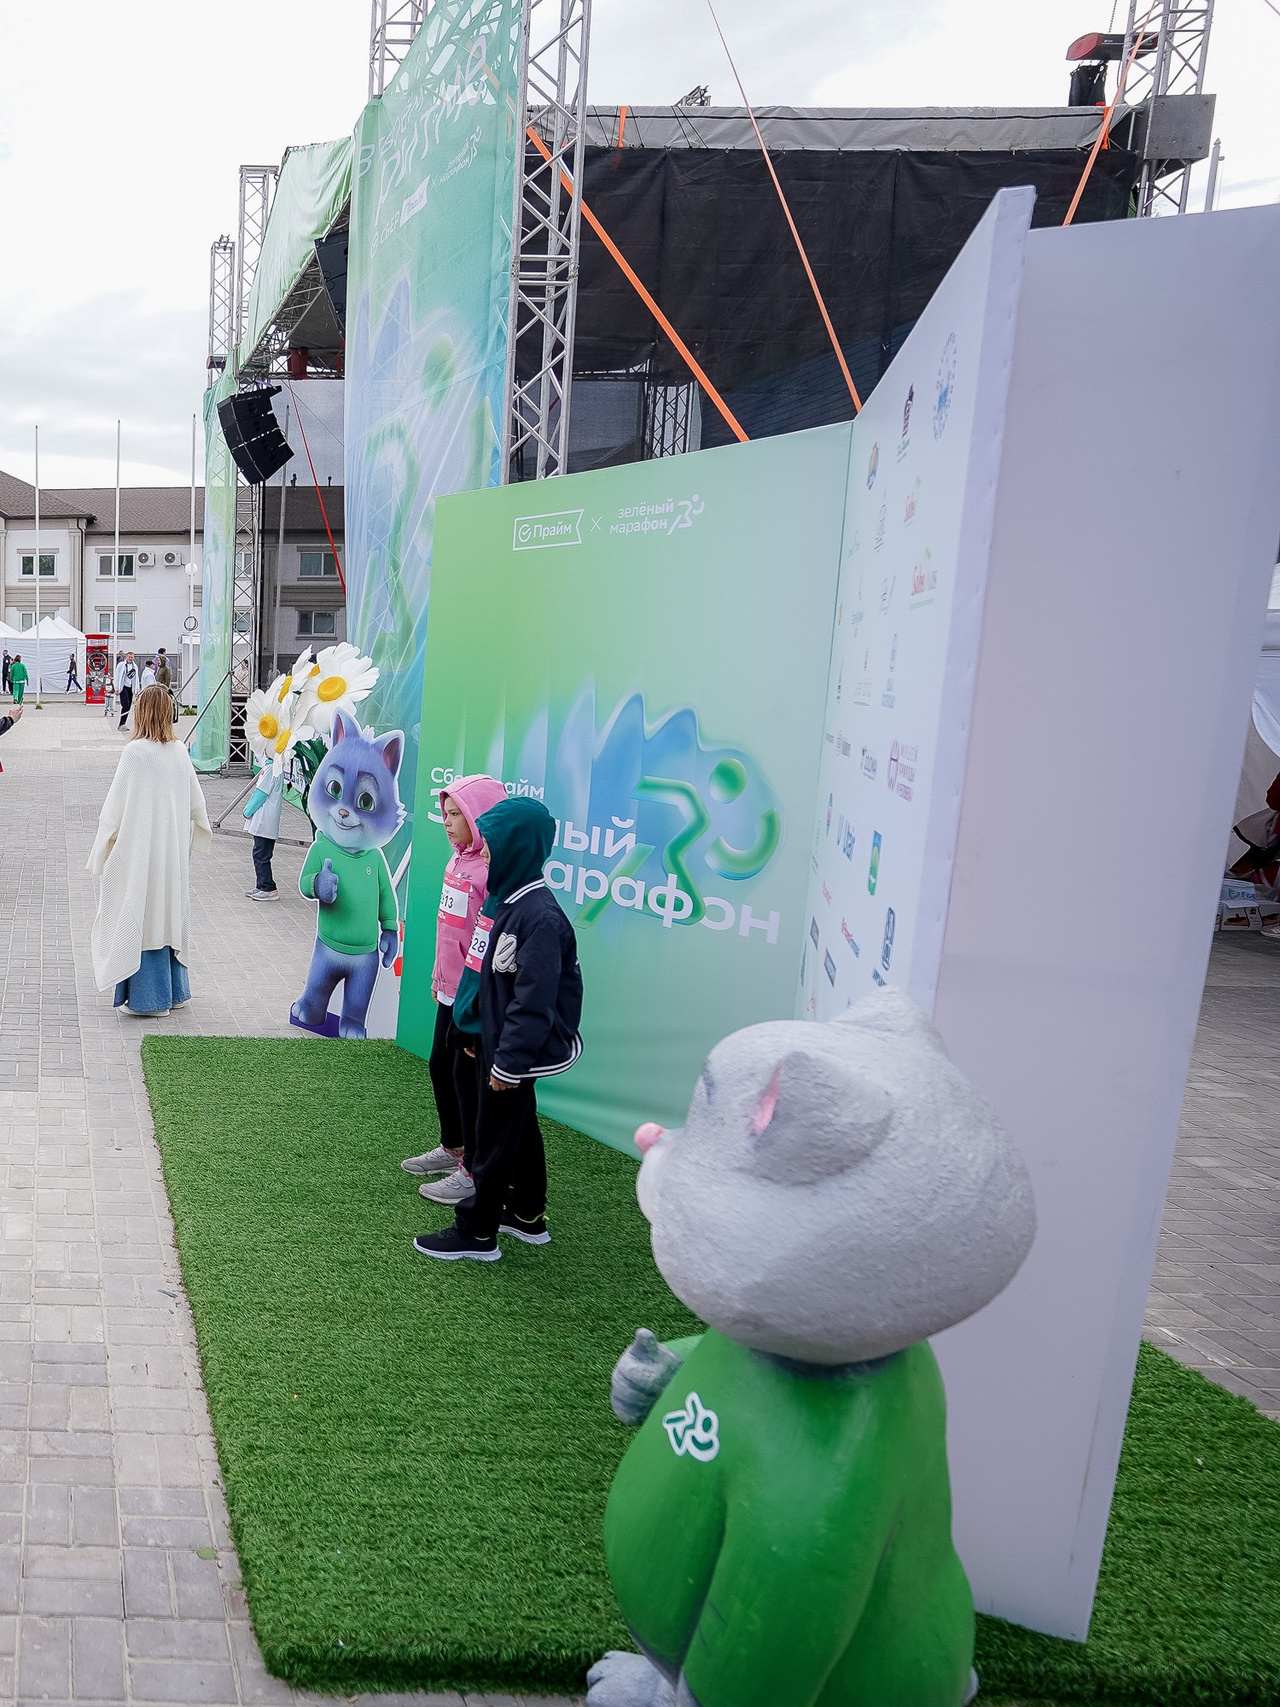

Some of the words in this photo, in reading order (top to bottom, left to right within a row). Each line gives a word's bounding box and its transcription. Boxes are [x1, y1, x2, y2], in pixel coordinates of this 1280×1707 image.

[618, 497, 674, 519] зелёный
[533, 520, 573, 540] Прайм
[609, 516, 668, 536] марафон
[543, 860, 781, 945] арафон
